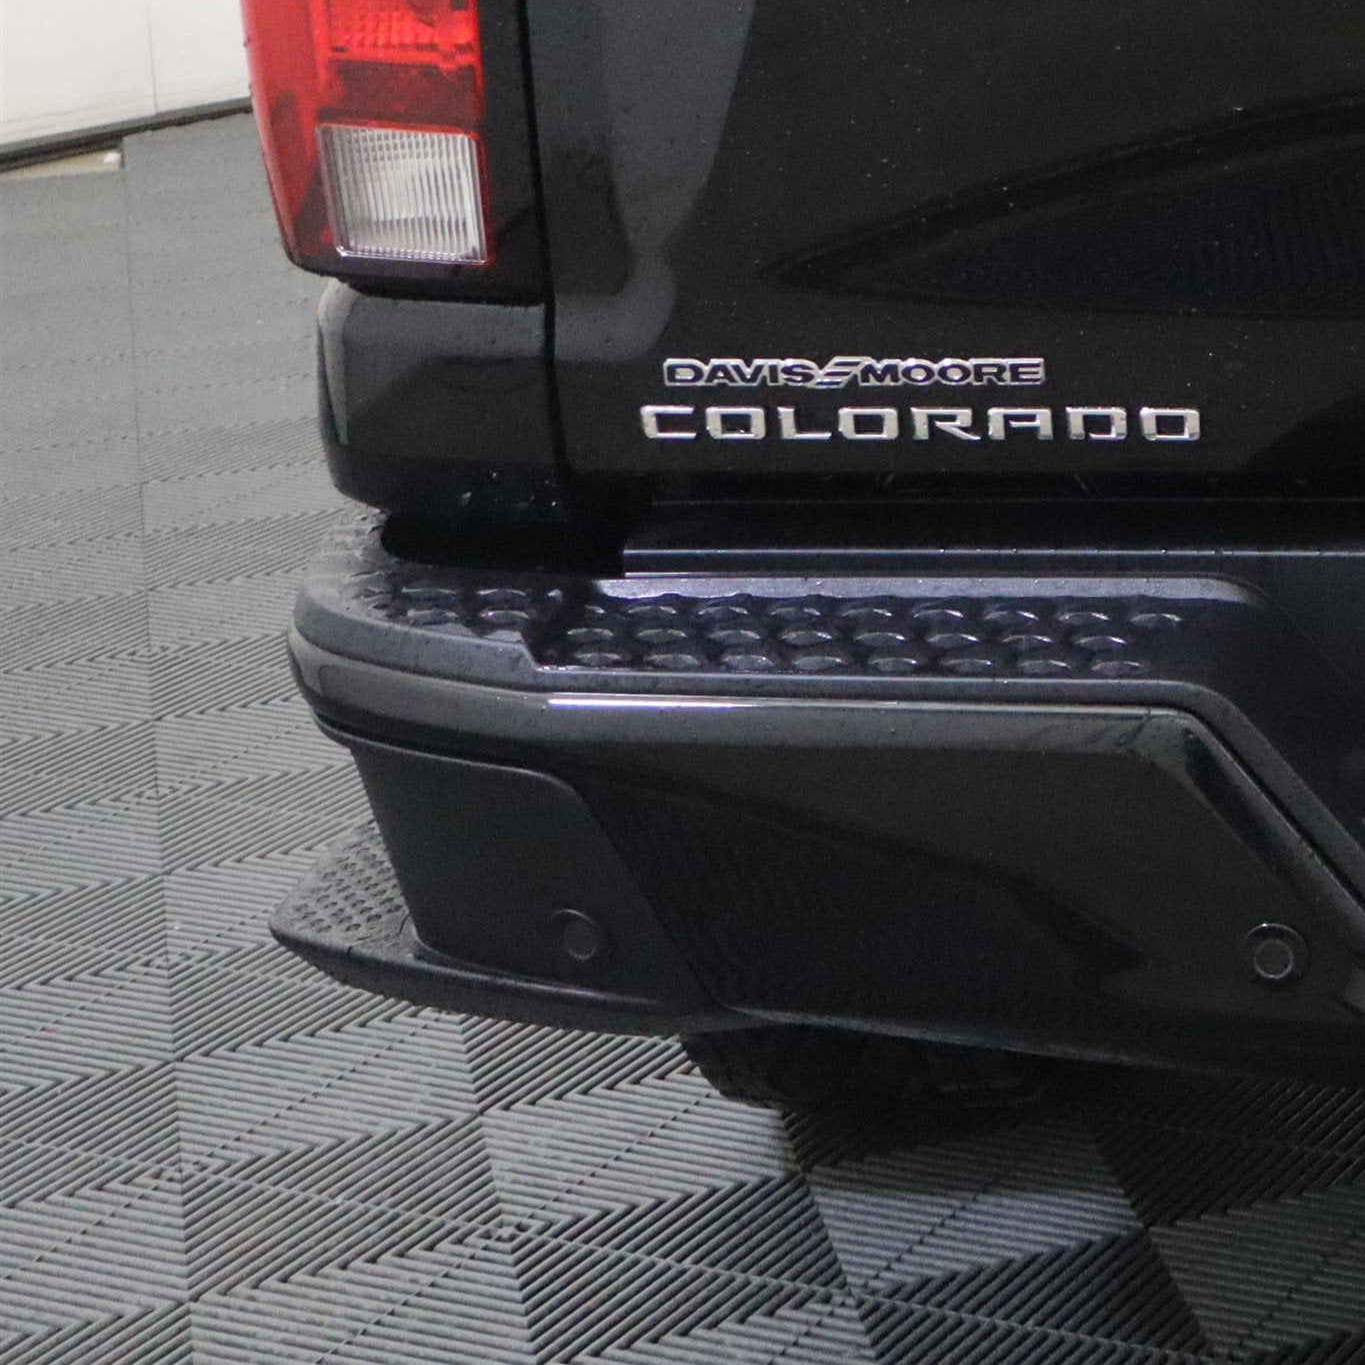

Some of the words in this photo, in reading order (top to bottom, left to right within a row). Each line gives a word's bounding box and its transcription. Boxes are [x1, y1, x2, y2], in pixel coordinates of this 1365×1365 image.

[663, 357, 816, 387] DAVIS
[858, 357, 1046, 386] MOORE
[640, 404, 1201, 441] COLORADO
